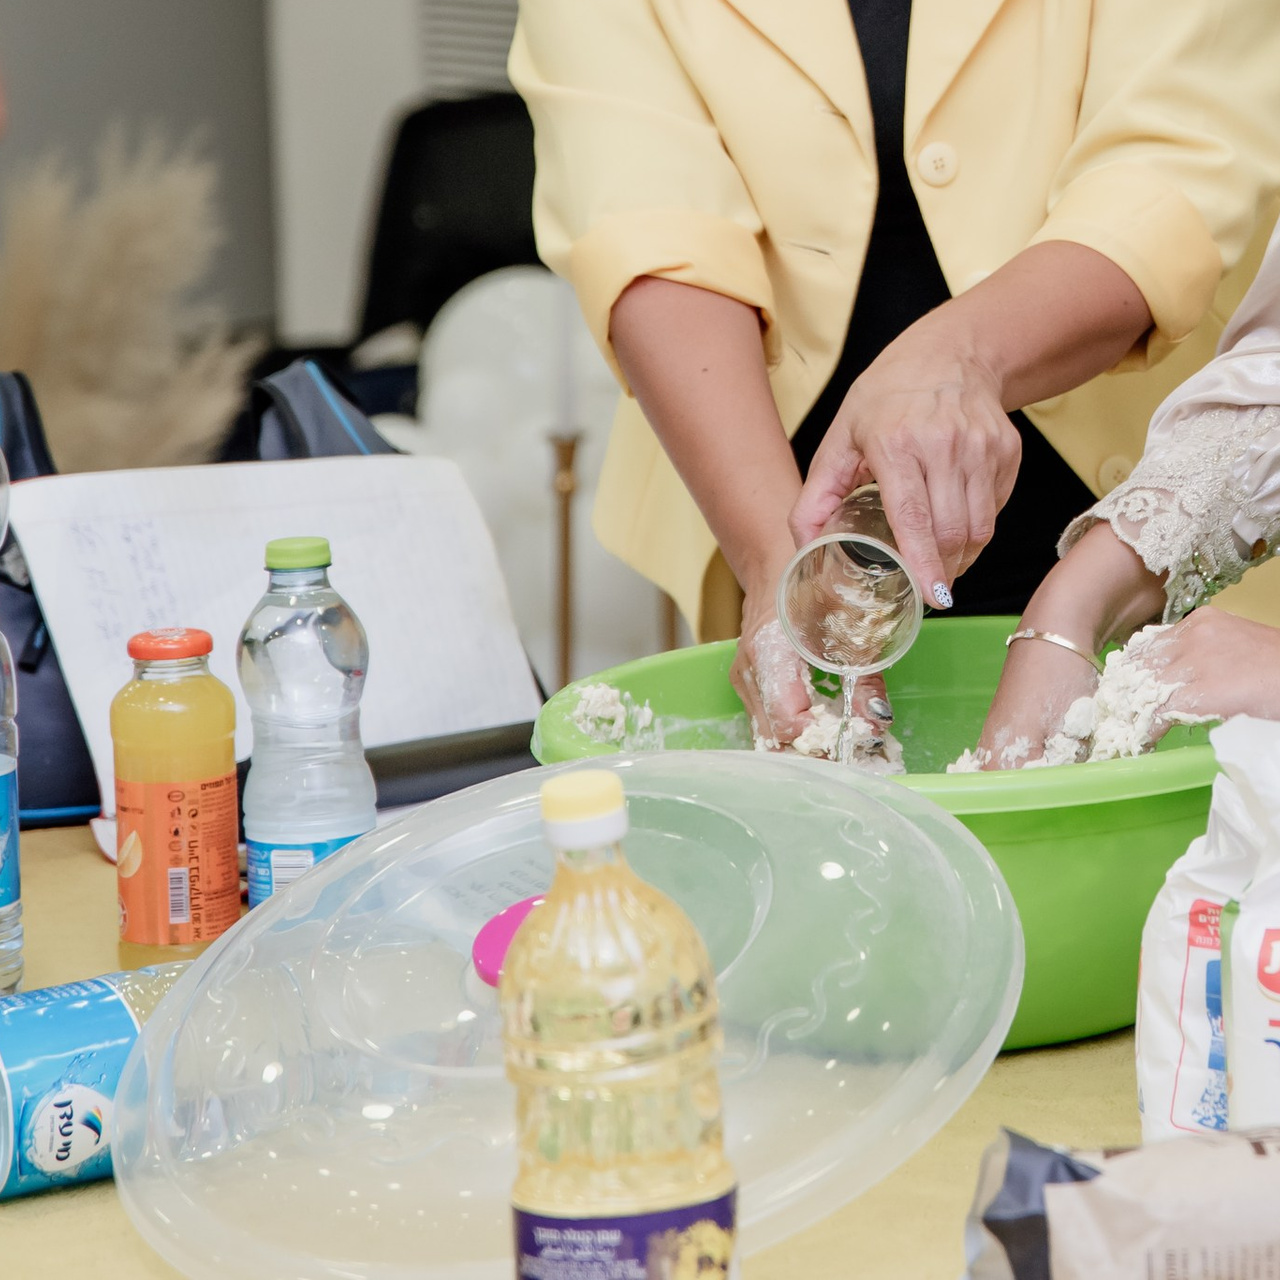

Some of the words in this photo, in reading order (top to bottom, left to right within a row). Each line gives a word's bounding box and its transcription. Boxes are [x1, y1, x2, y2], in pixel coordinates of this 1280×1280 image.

[188, 840, 199, 863] חייב
[189, 867, 203, 911] בפיקדון
[53, 1100, 74, 1137] עדן
[56, 1140, 72, 1161] מי
